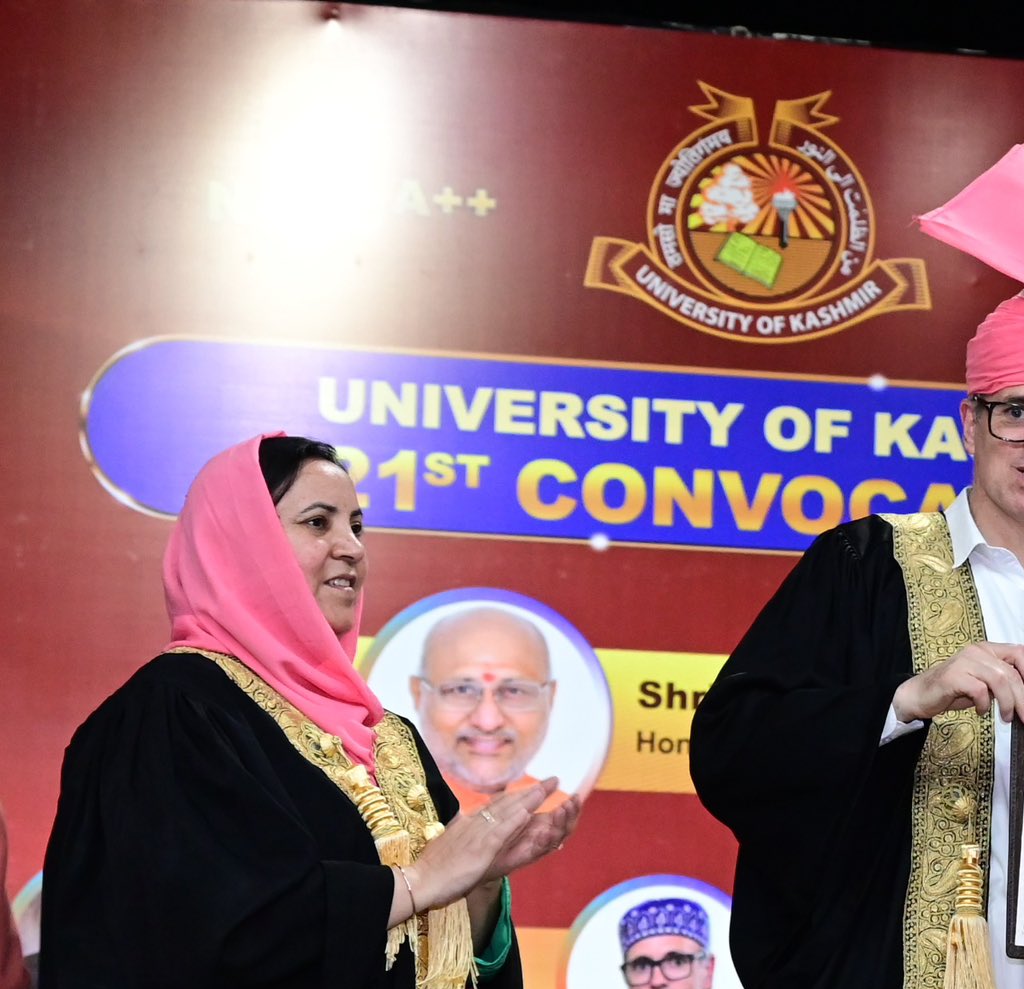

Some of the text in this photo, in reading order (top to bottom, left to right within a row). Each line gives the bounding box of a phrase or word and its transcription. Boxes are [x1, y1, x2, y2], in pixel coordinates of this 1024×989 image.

[635, 264, 882, 335] UNIVERSITY OF KASHMIR
[318, 376, 745, 448] UNIVERSITY
[763, 405, 853, 454] OF
[638, 680, 708, 710] Shr
